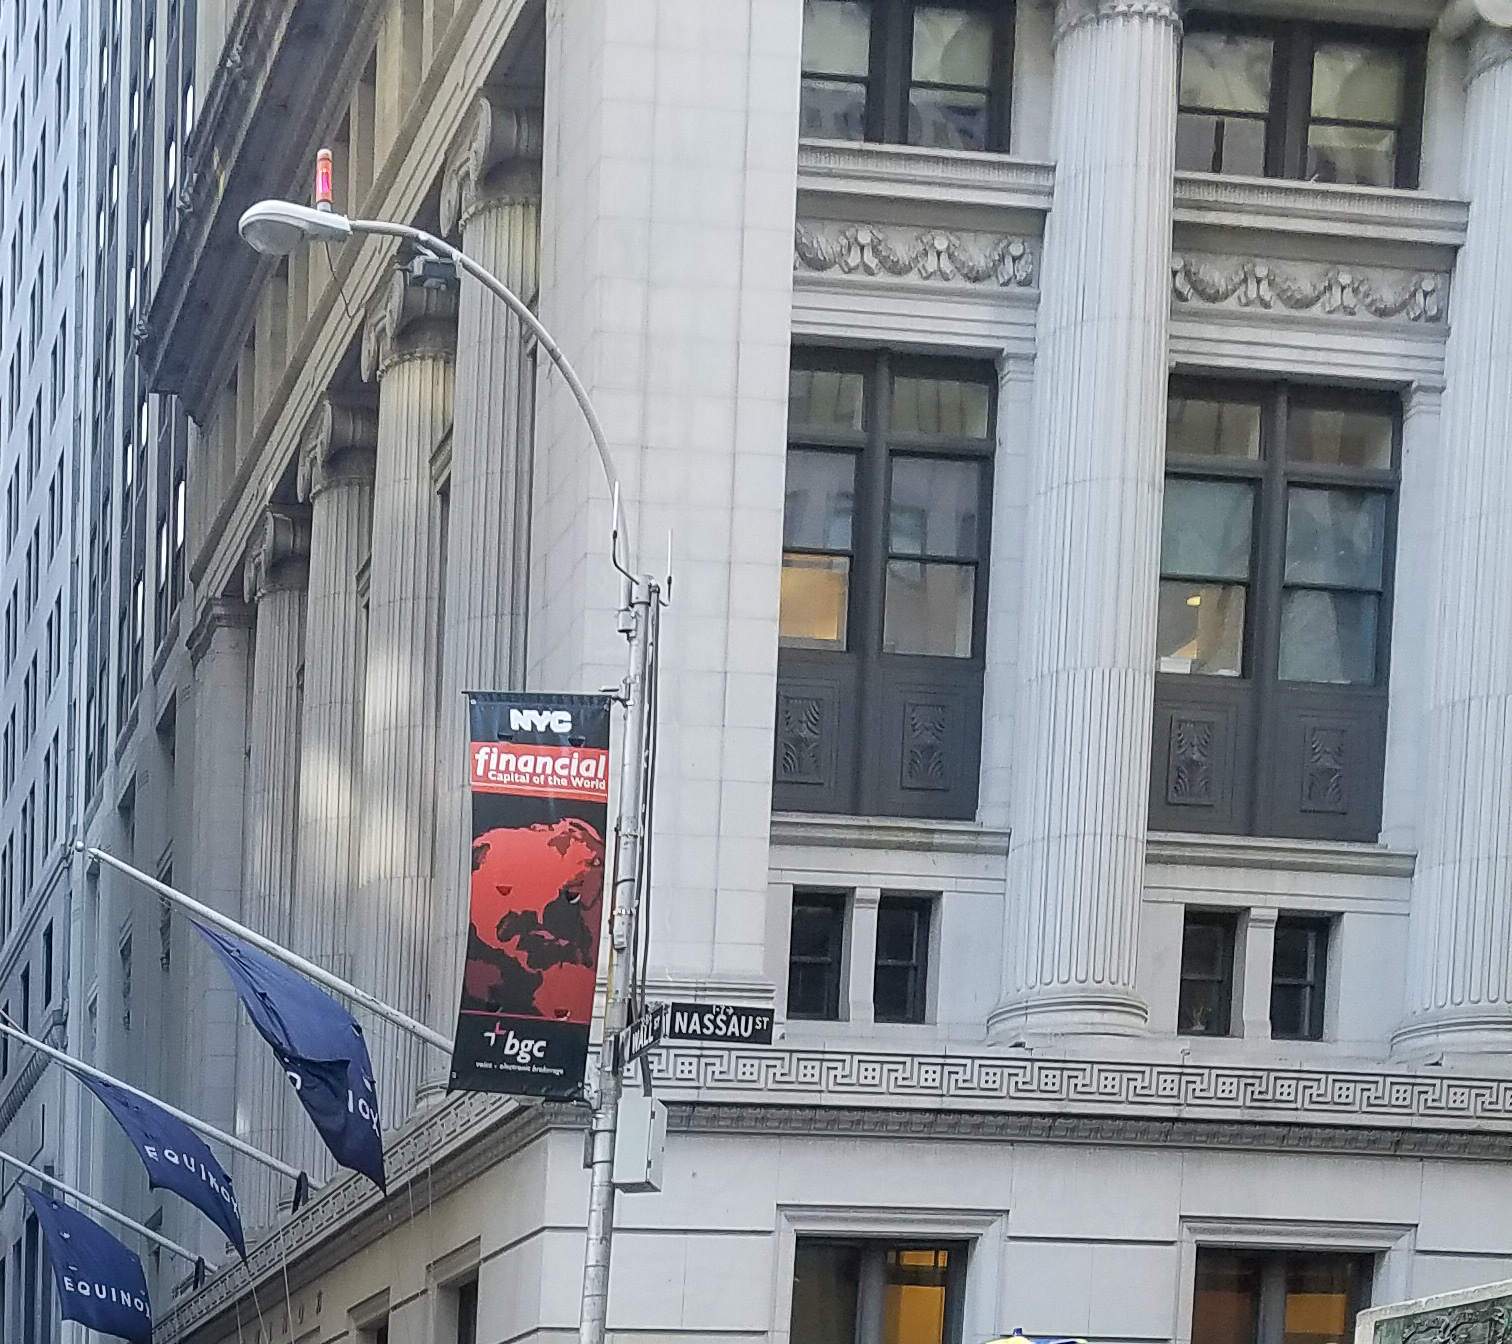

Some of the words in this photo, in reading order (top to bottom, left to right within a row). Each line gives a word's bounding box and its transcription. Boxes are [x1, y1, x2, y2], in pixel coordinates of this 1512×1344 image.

[509, 708, 572, 733] NYC
[474, 746, 607, 779] financial
[488, 770, 530, 784] Capital
[532, 774, 545, 785] of
[548, 775, 568, 787] the
[571, 777, 606, 790] World
[631, 1020, 654, 1055] WALL
[674, 1011, 754, 1038] NASSAU
[755, 1016, 770, 1030] ST
[503, 1030, 547, 1064] bgc
[143, 1145, 240, 1220] EQUINOX
